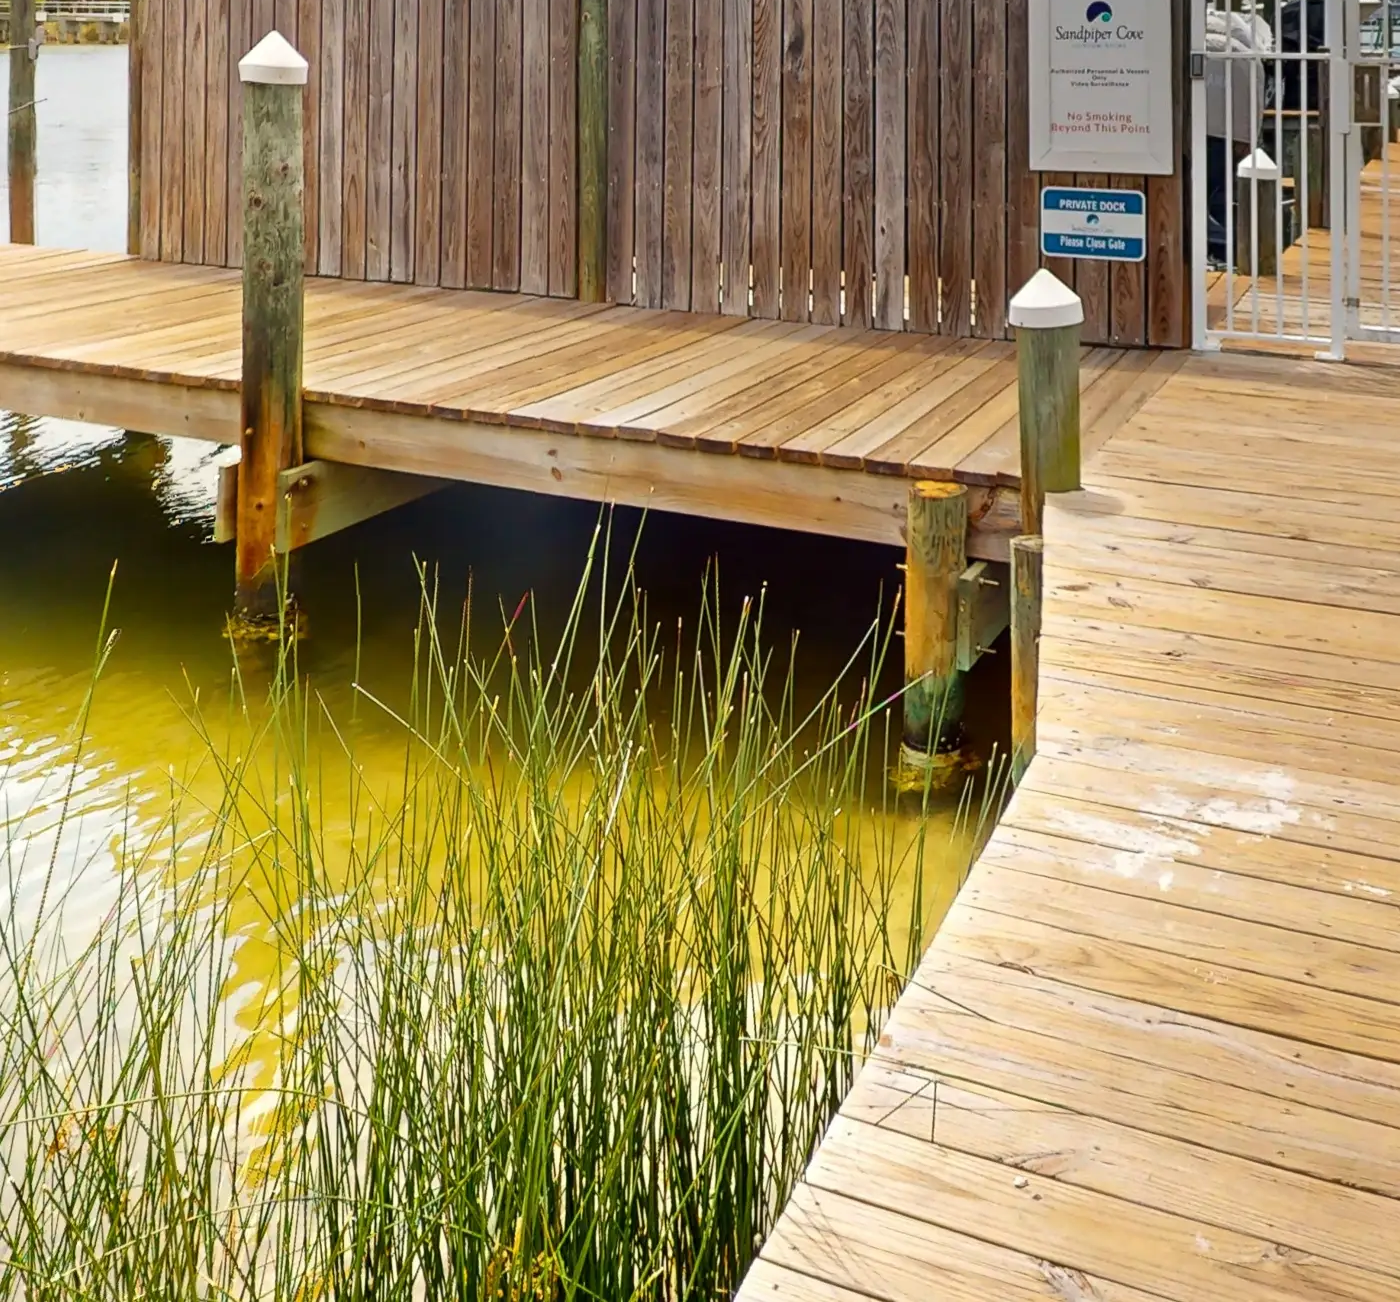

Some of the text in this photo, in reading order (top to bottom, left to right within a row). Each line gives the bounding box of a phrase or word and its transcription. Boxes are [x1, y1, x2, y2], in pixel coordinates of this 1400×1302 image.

[1055, 24, 1144, 43] Sandpiper Cove
[1067, 111, 1132, 123] No Smoking
[1050, 123, 1150, 134] Beyond This Point
[1059, 199, 1126, 212] PRIVATE DOCK
[1060, 236, 1126, 250] Please Close Gate
